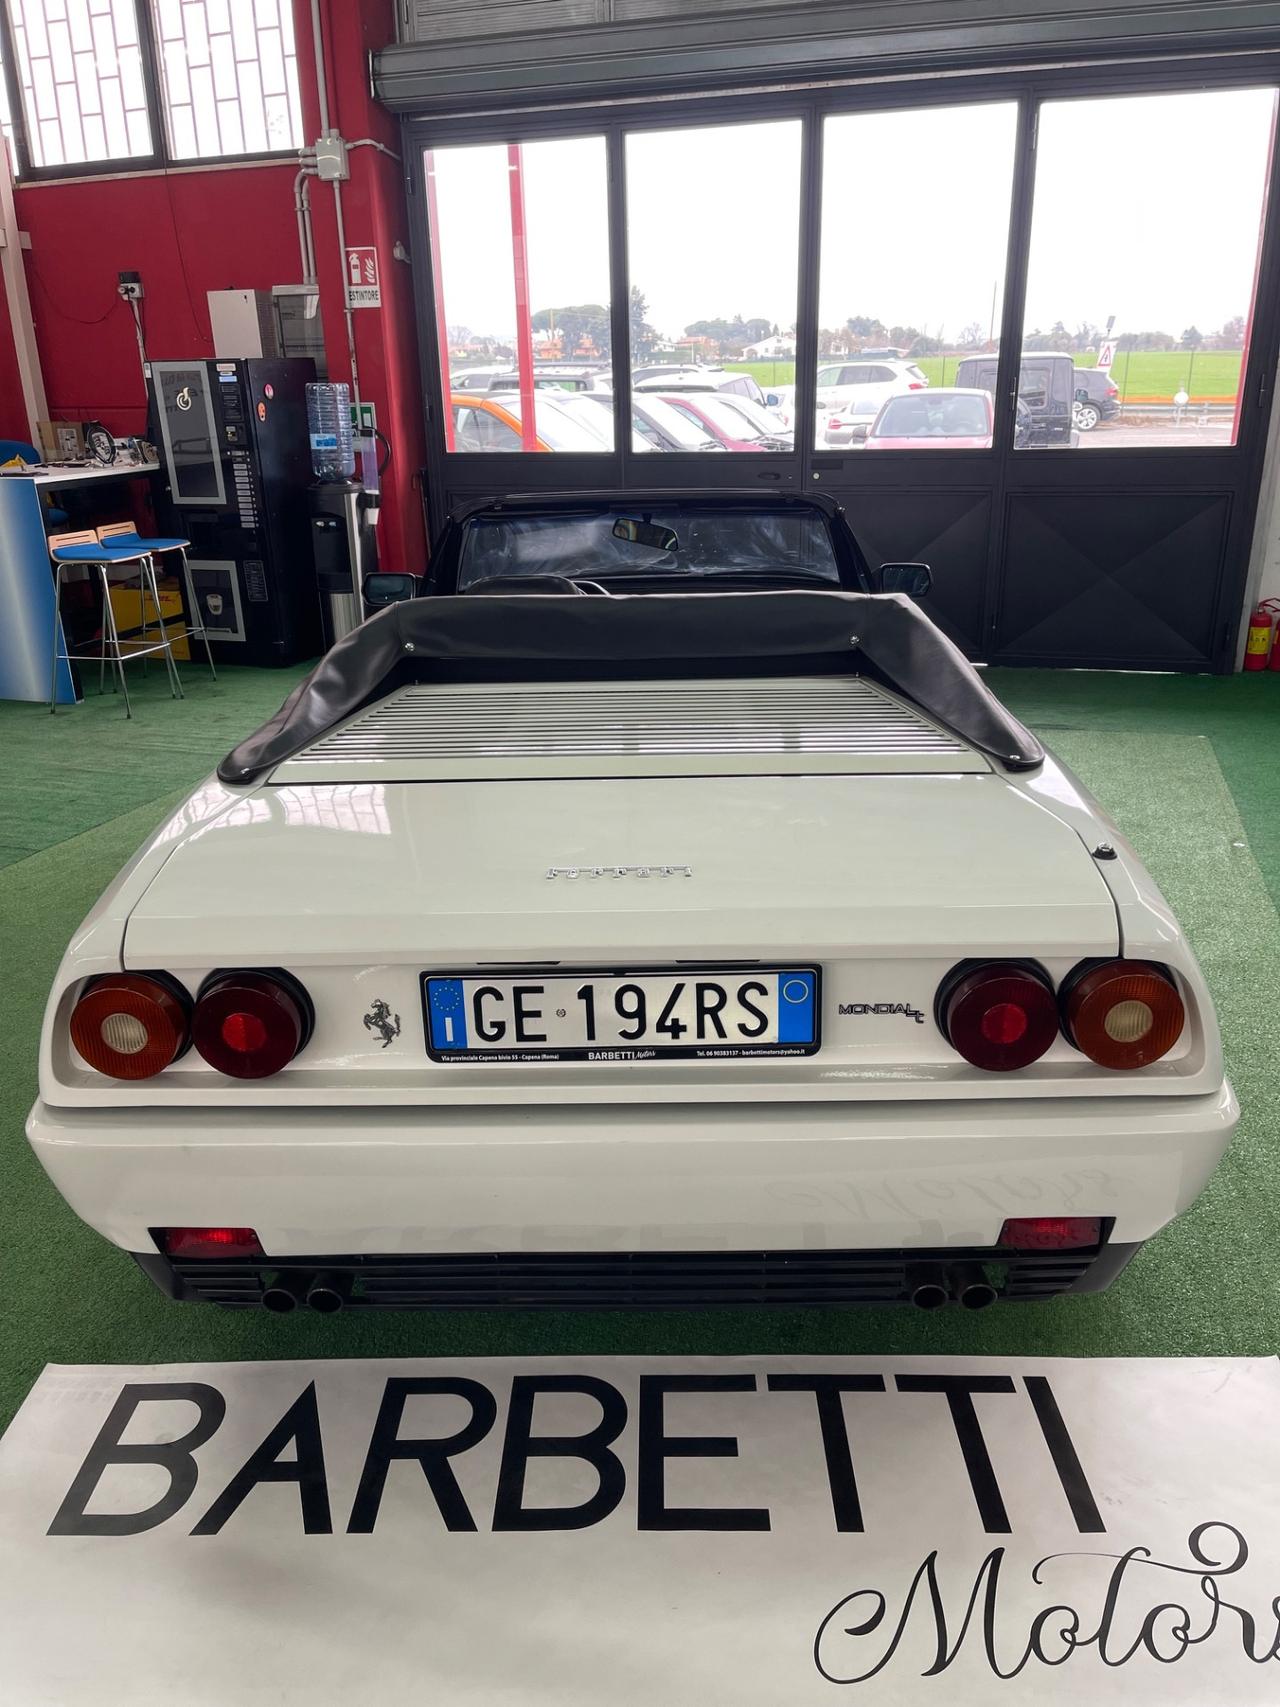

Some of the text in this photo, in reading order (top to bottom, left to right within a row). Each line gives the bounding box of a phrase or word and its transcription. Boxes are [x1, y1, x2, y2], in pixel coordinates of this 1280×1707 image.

[348, 290, 379, 301] ESTINTORE
[473, 981, 768, 1042] GE 194RS
[838, 1003, 920, 1017] MONDIAL
[588, 1052, 634, 1060] BARBETTI
[46, 1374, 1106, 1537] BARBETTI
